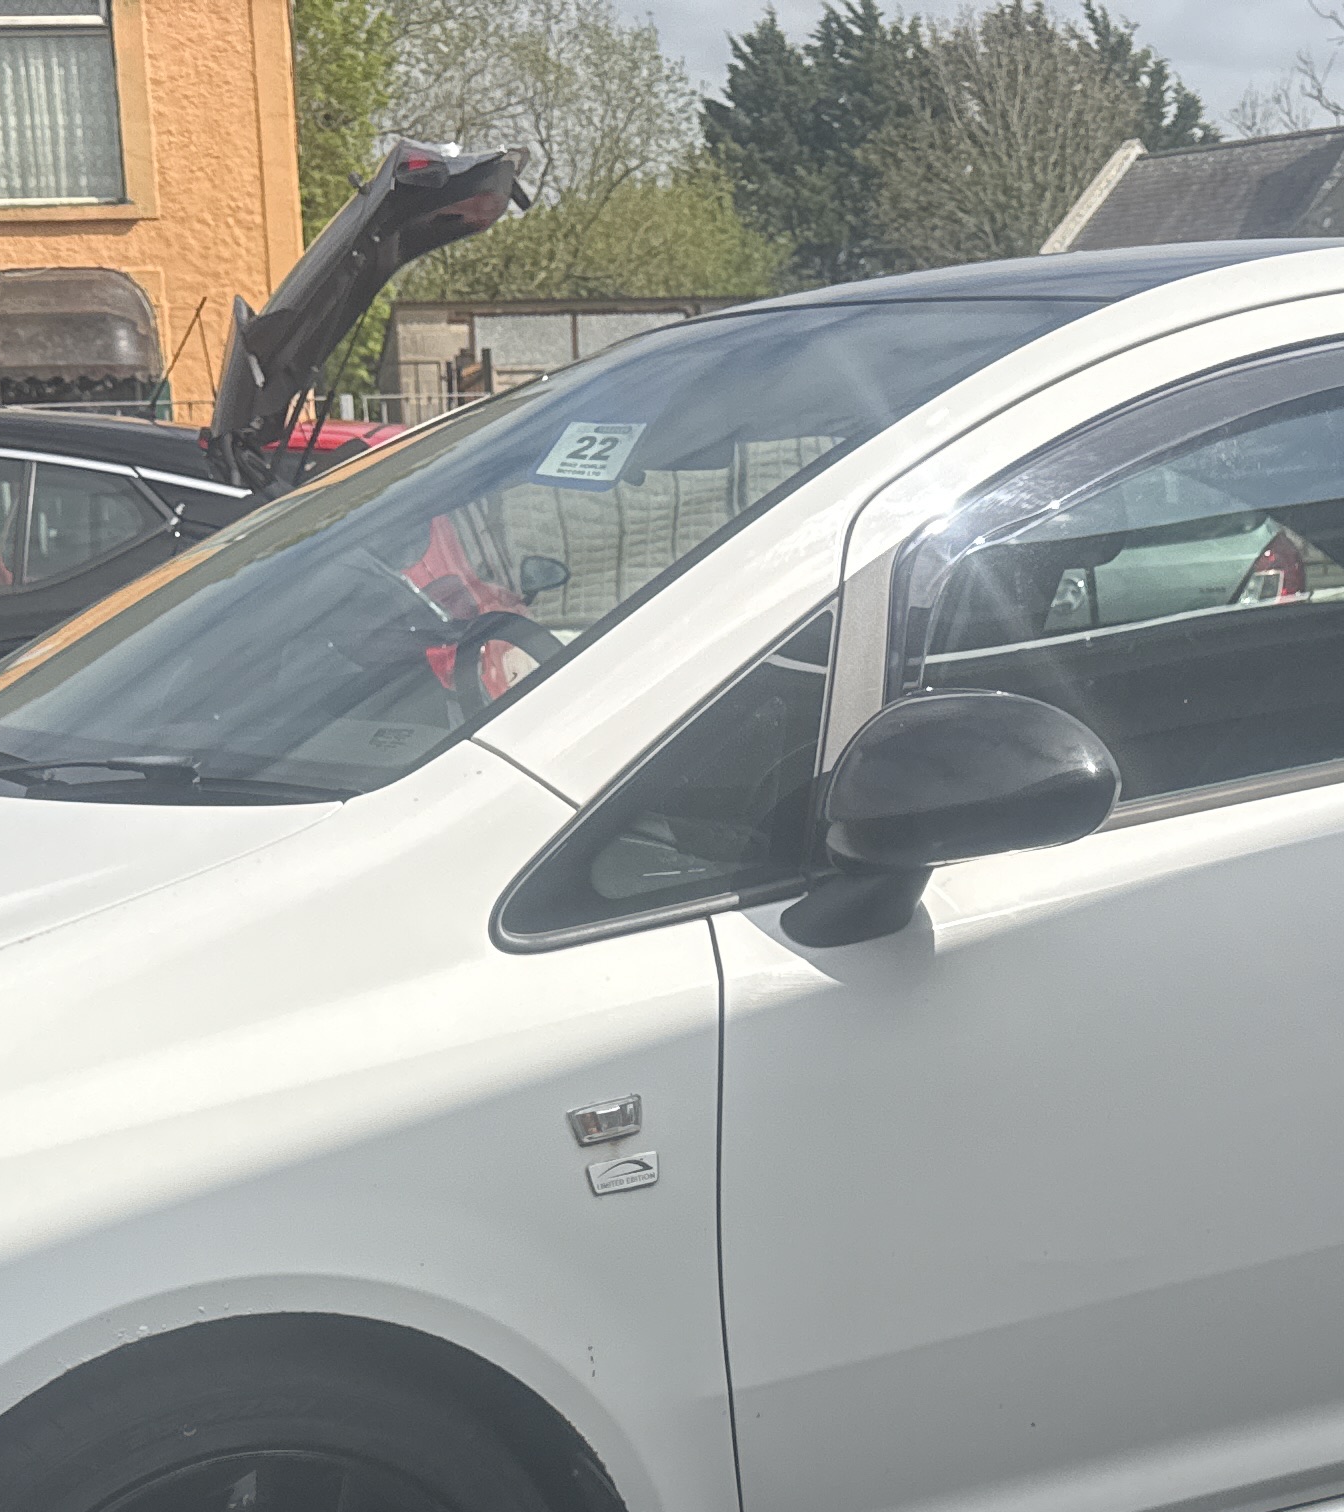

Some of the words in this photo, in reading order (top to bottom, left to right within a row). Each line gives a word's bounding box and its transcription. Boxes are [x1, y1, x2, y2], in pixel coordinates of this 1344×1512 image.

[565, 435, 619, 461] 22
[596, 1178, 625, 1191] LIMITED
[626, 1171, 656, 1185] EDITION
